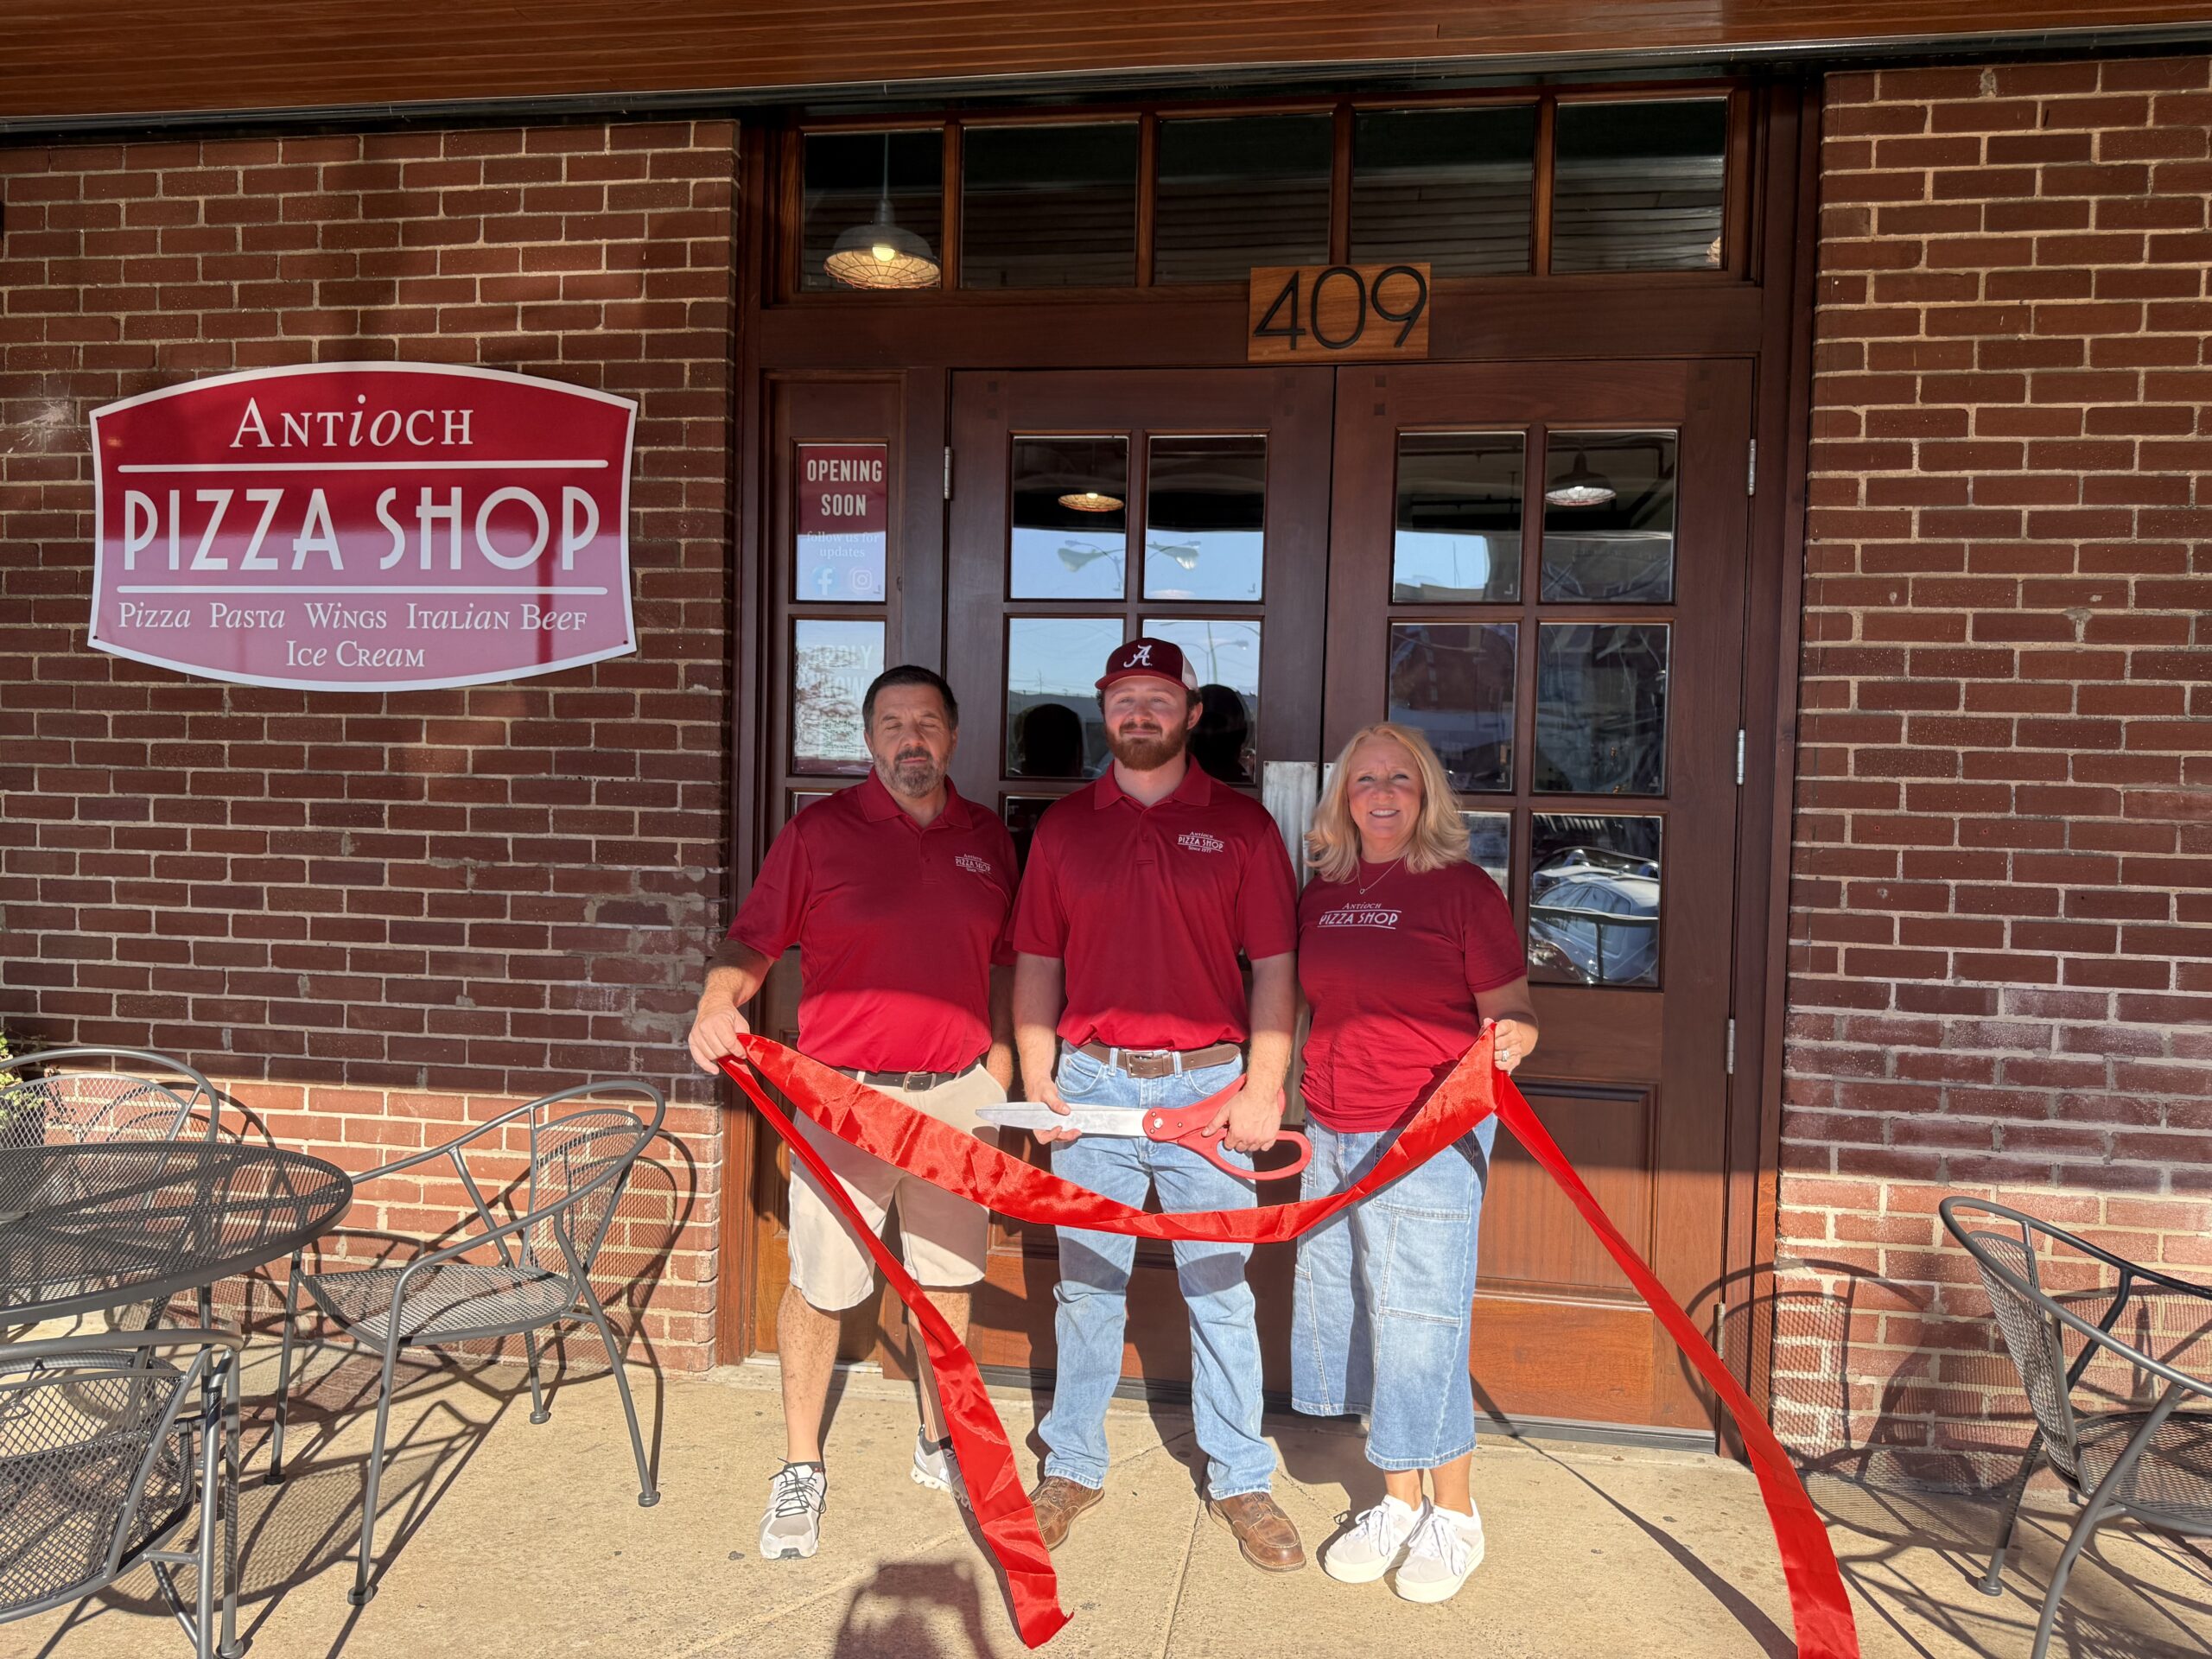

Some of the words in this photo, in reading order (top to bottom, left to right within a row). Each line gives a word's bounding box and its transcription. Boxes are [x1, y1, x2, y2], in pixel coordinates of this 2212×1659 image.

[1253, 265, 1427, 350] 409
[806, 459, 883, 482] OPENING
[821, 493, 867, 517] SOON
[124, 488, 345, 571] PIZZA
[375, 486, 601, 571] SHOP
[806, 531, 842, 543] follow
[846, 533, 859, 543] us
[862, 531, 880, 543] for
[819, 546, 865, 560] updates
[1178, 836, 1200, 844] PIZZA
[1202, 839, 1224, 850] SHOP
[955, 857, 975, 868] PIZZA
[1319, 912, 1354, 925] PIZZA
[1357, 912, 1399, 925] SHOP
